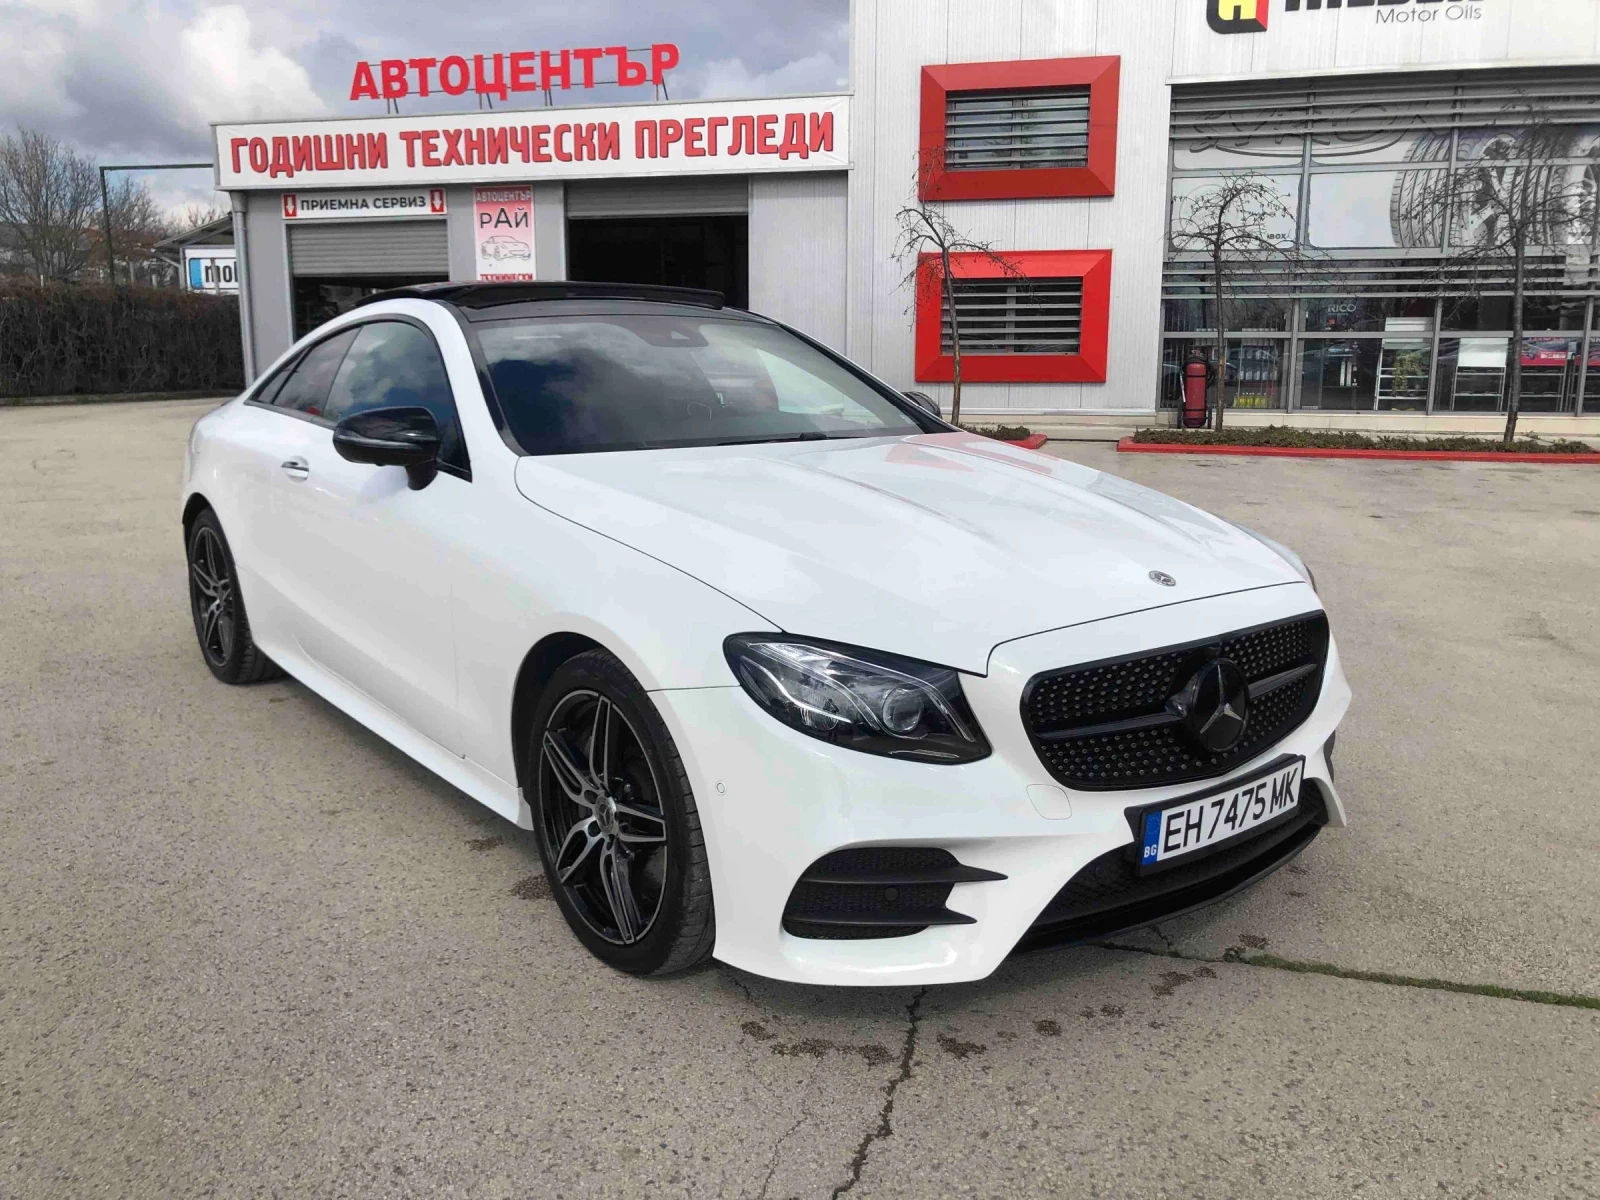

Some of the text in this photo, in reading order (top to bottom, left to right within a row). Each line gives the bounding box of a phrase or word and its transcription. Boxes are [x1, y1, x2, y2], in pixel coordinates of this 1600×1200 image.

[1376, 7, 1439, 24] Motor
[1445, 4, 1482, 21] Oils
[350, 43, 680, 101] АВТОЦЕНТЪР
[230, 111, 834, 179] ГОДИШНИ ТЕХНИЧЕСКИ ПРЕГЛЕДИ
[300, 196, 427, 211] ПРИЕМНА СЕРВИЗ
[476, 190, 531, 202] АВТОЦЕНТЪР
[479, 207, 529, 229] РАЙ
[1143, 844, 1158, 859] BG
